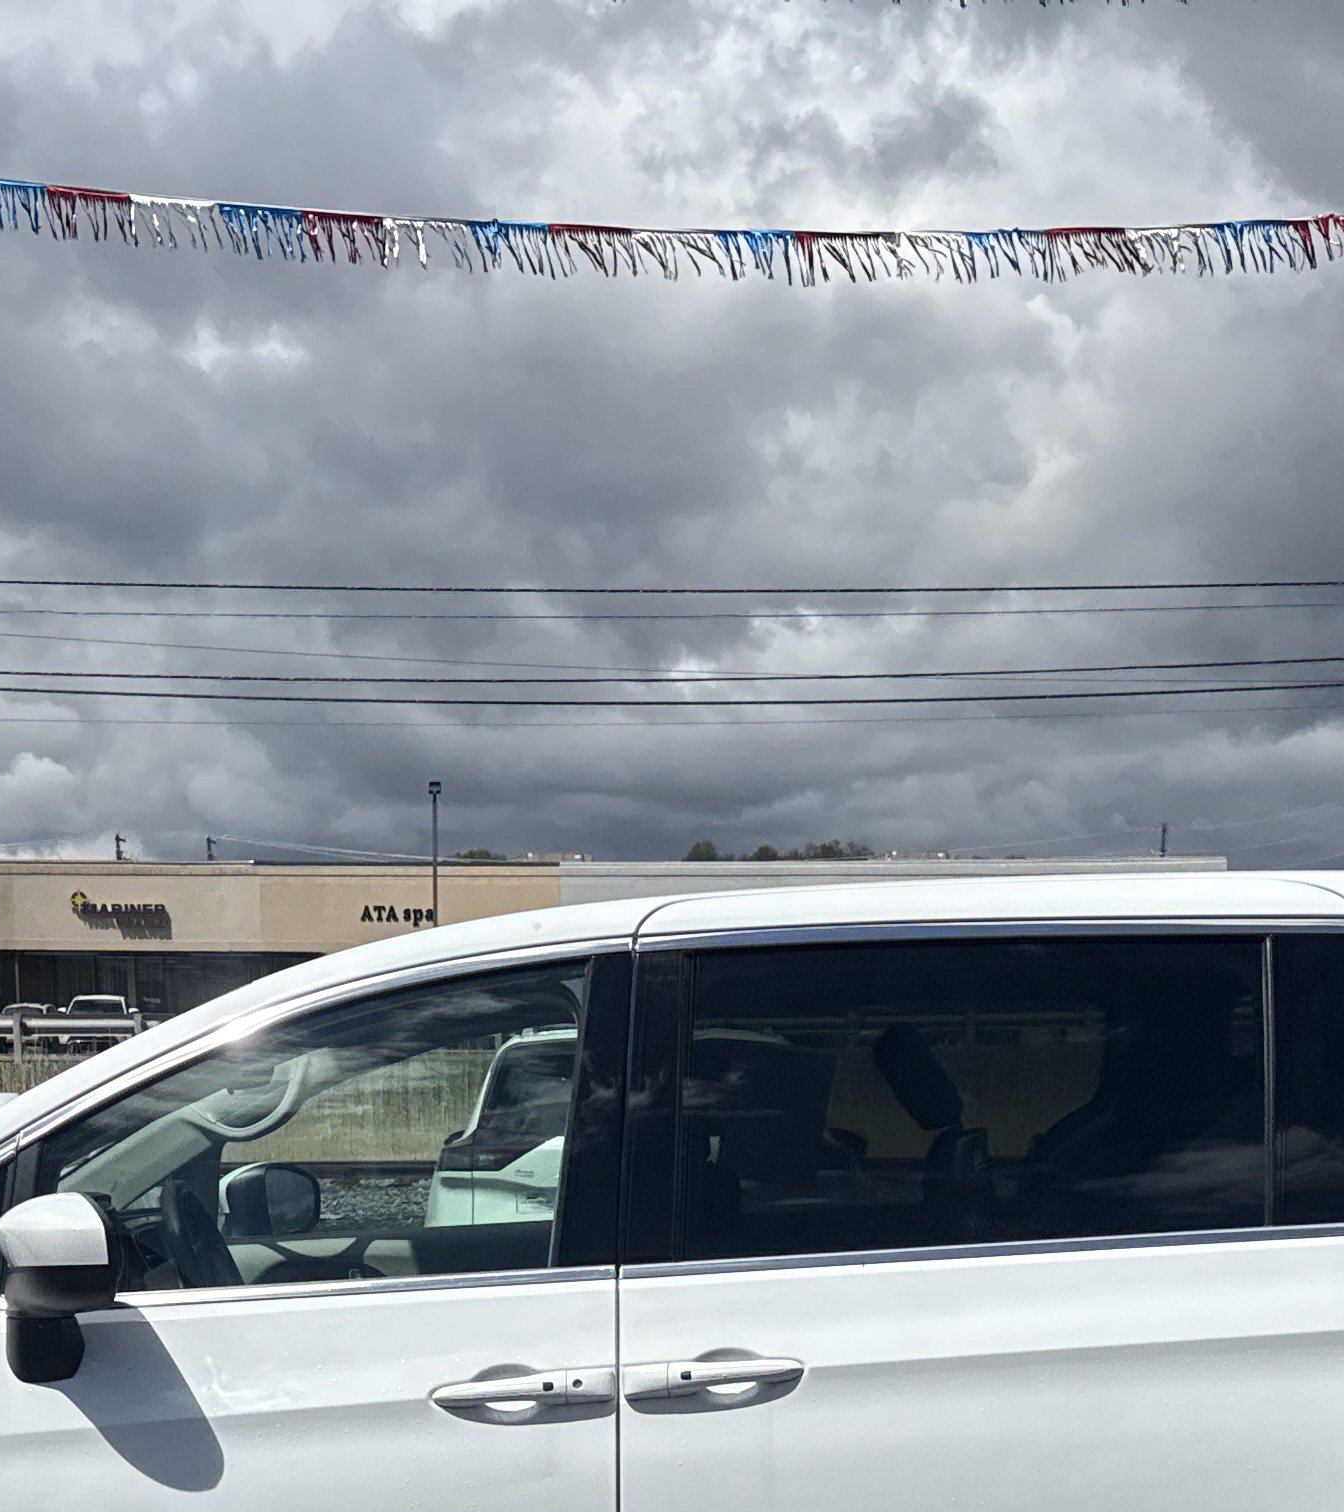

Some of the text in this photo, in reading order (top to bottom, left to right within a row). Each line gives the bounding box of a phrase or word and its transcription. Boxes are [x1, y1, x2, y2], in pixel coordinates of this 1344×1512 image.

[81, 903, 166, 914] MARINER
[360, 905, 434, 928] ATA spa
